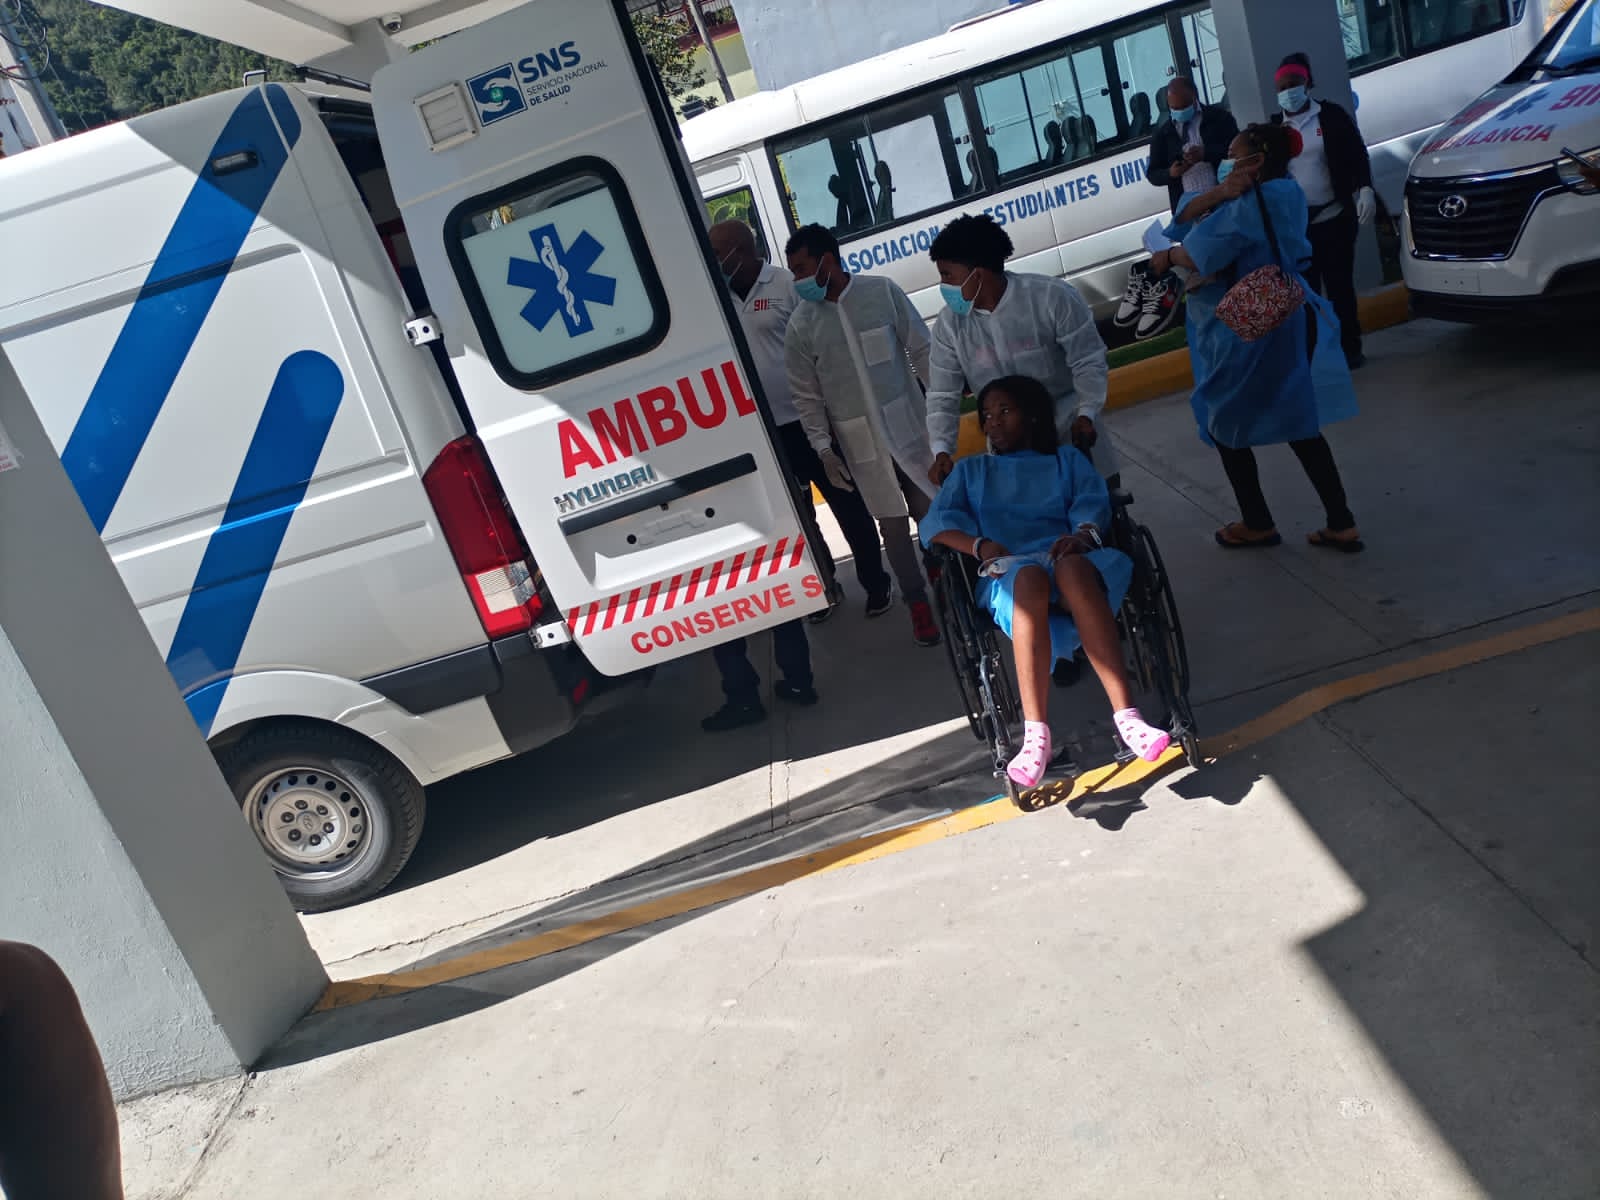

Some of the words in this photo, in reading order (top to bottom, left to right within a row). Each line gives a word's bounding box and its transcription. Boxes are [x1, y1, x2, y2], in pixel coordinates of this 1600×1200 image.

[518, 41, 581, 83] SNS
[527, 77, 564, 96] SERVICIO
[565, 60, 608, 81] NACIONAL
[530, 95, 543, 106] DE
[542, 84, 571, 102] SALUD
[557, 361, 757, 479] AMBUL
[554, 464, 659, 513] HYUNDAI
[631, 583, 796, 654] CONSERVE
